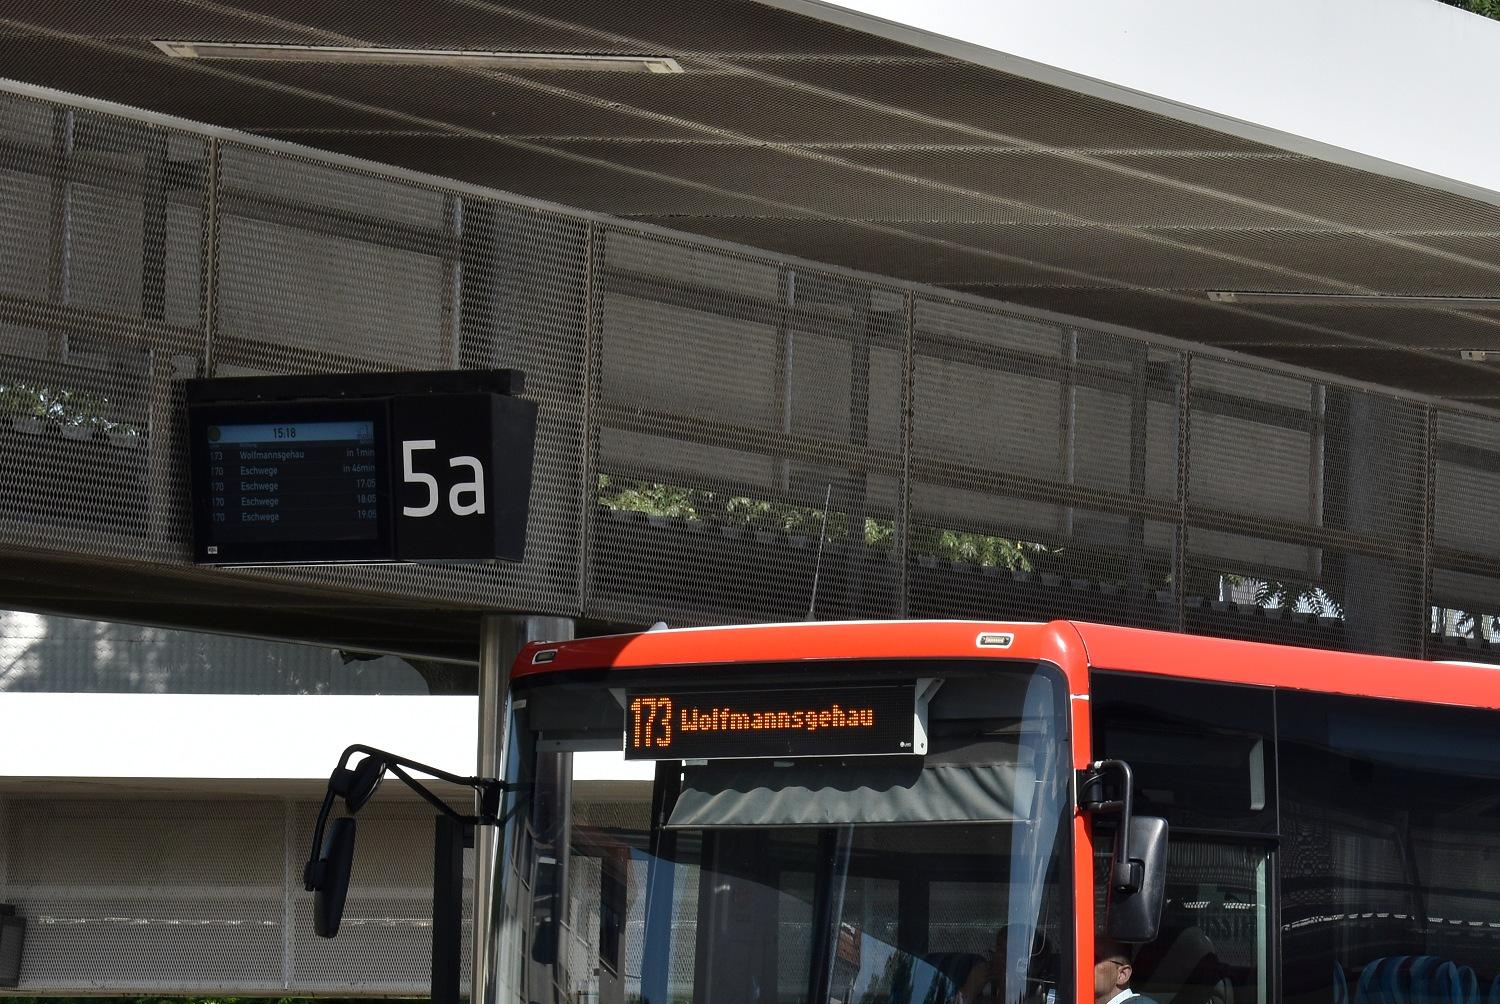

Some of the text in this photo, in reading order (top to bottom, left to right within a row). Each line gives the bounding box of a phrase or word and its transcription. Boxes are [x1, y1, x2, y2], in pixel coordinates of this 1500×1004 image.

[273, 427, 296, 439] 15:18
[240, 450, 304, 461] Wolfmannsgehau
[346, 449, 354, 457] in
[240, 466, 278, 477] Eschwege
[343, 465, 351, 473] in
[403, 440, 485, 517] 5a
[241, 481, 279, 493] Eschwege
[241, 497, 279, 508] Eschwege
[242, 512, 280, 523] Eschwege
[630, 697, 873, 748] 173 Wolfmannsgehau
